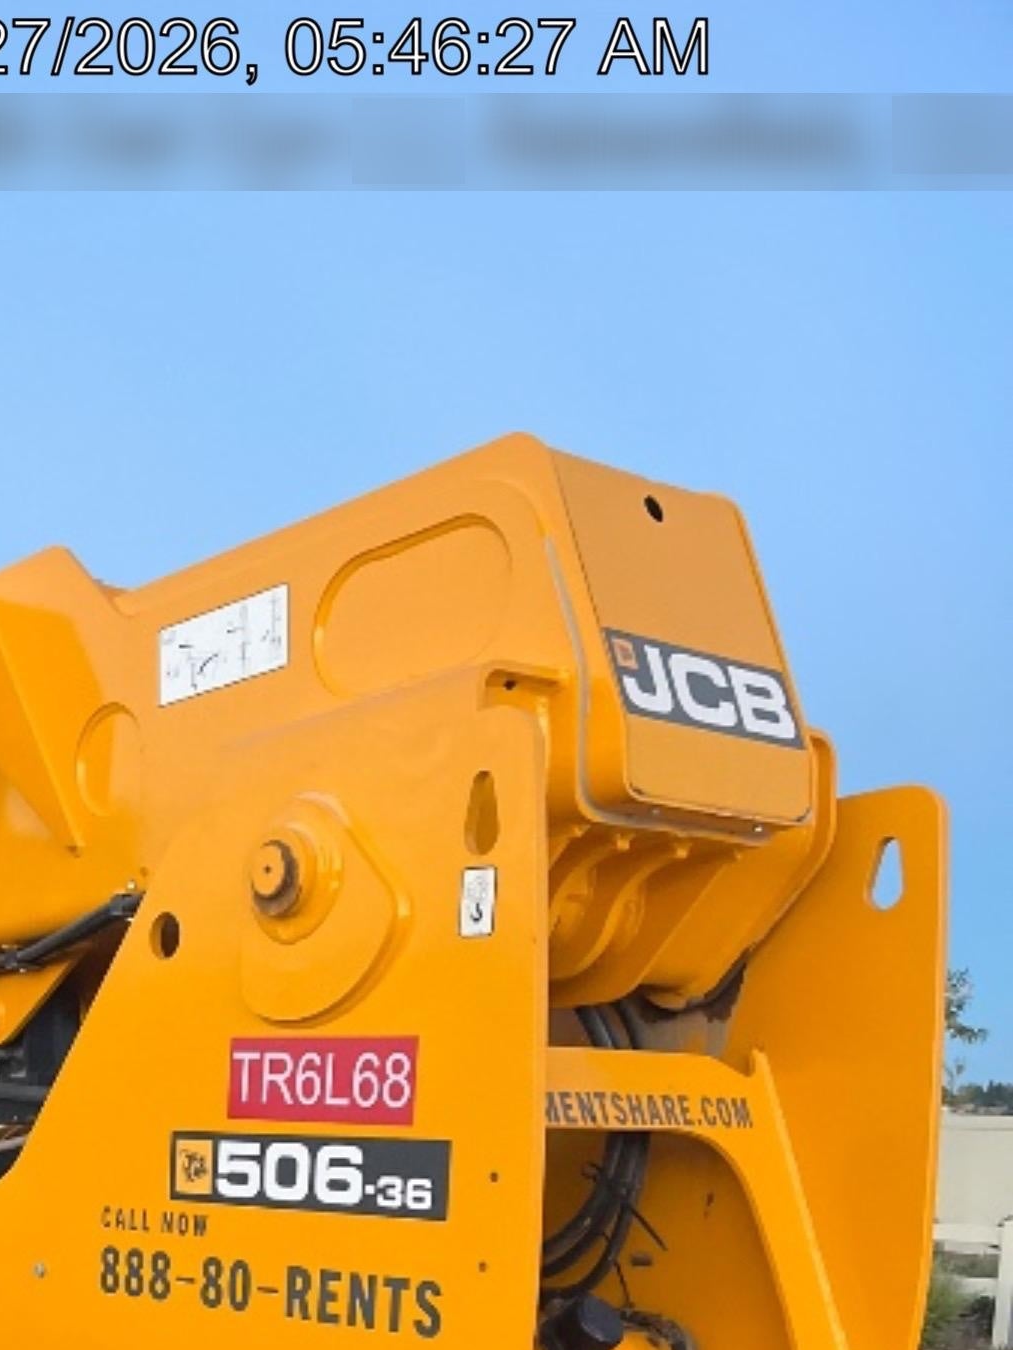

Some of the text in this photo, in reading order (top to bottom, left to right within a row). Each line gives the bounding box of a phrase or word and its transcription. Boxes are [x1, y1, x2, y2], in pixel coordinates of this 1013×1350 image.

[622, 644, 796, 739] JCB
[232, 1052, 412, 1109] TR6L68
[101, 1207, 209, 1237] CALL NOW
[100, 1245, 443, 1339] 888-80-RENTS
